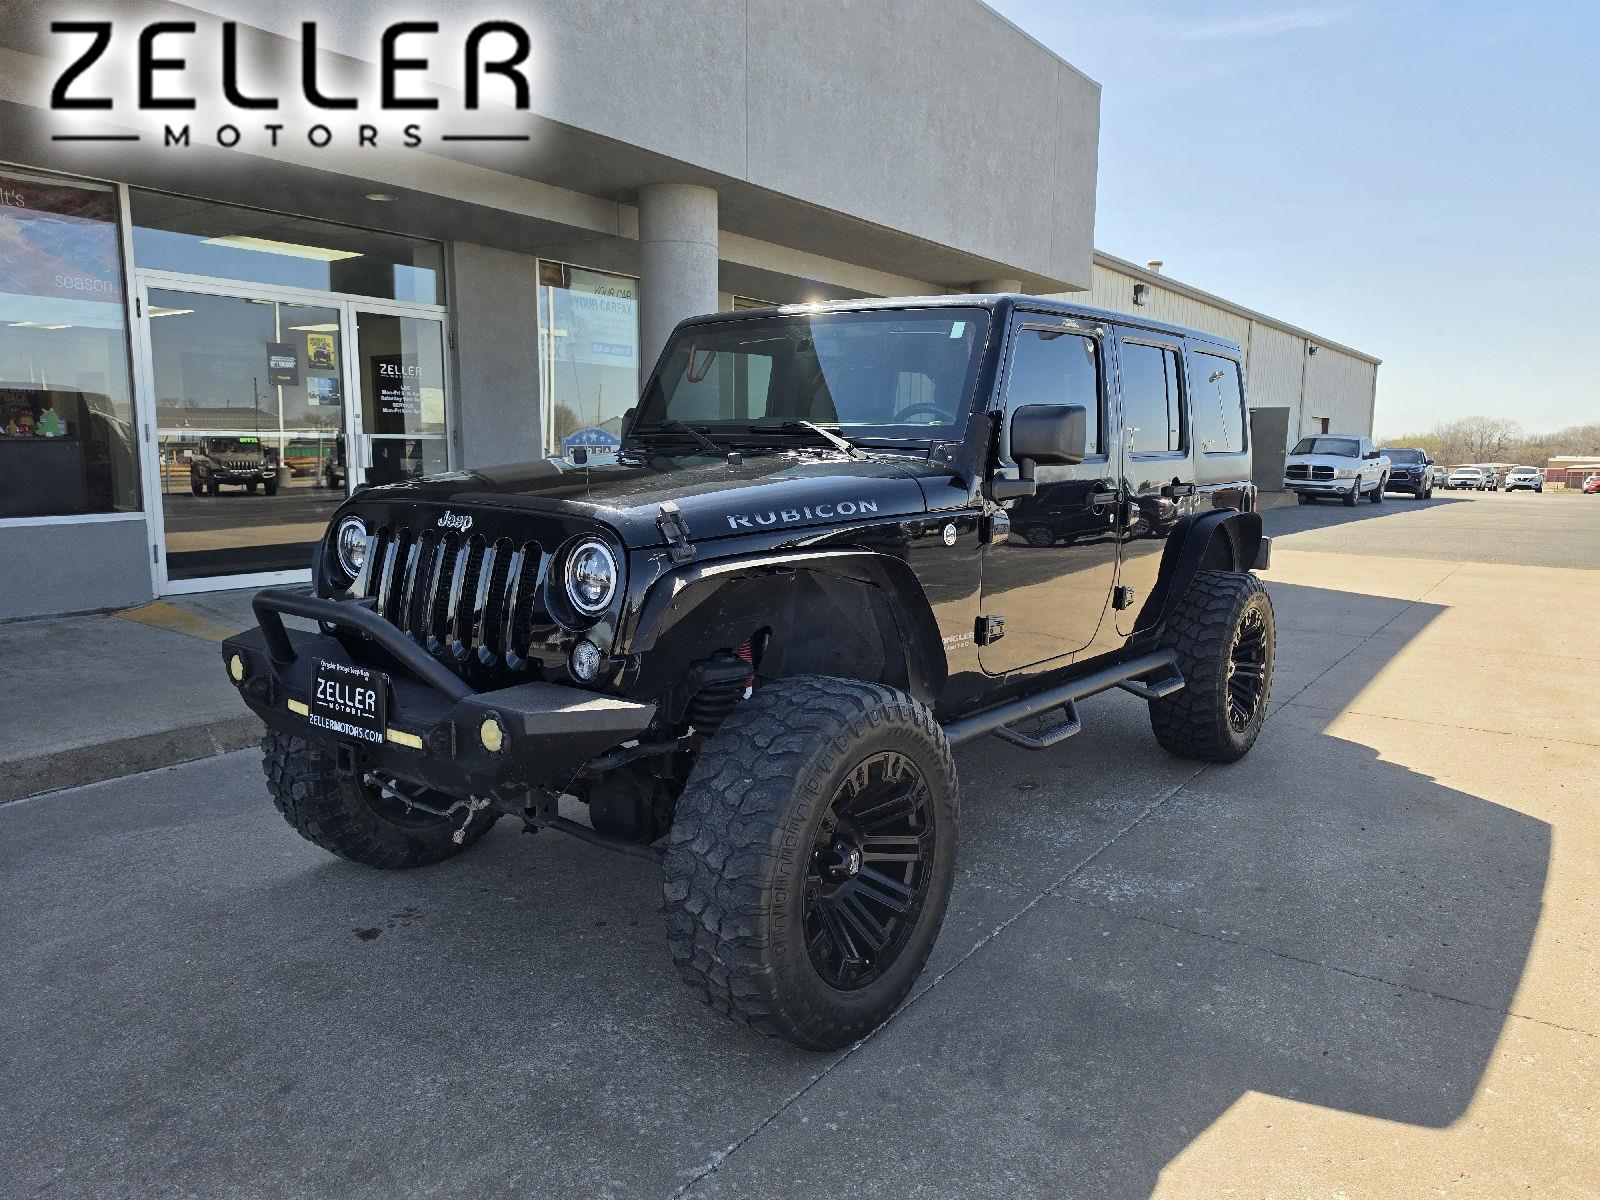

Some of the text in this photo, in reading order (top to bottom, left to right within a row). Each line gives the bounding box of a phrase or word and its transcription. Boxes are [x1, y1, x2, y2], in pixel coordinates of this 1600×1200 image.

[574, 296, 632, 316] YOUR CARFAX
[380, 363, 422, 376] ZELLER
[437, 510, 473, 532] Jeep
[726, 500, 878, 529] RUBICON
[316, 677, 376, 712] ZELLER
[328, 702, 361, 717] MOTORS
[309, 713, 383, 744] ZELLERMOTORS.COM
